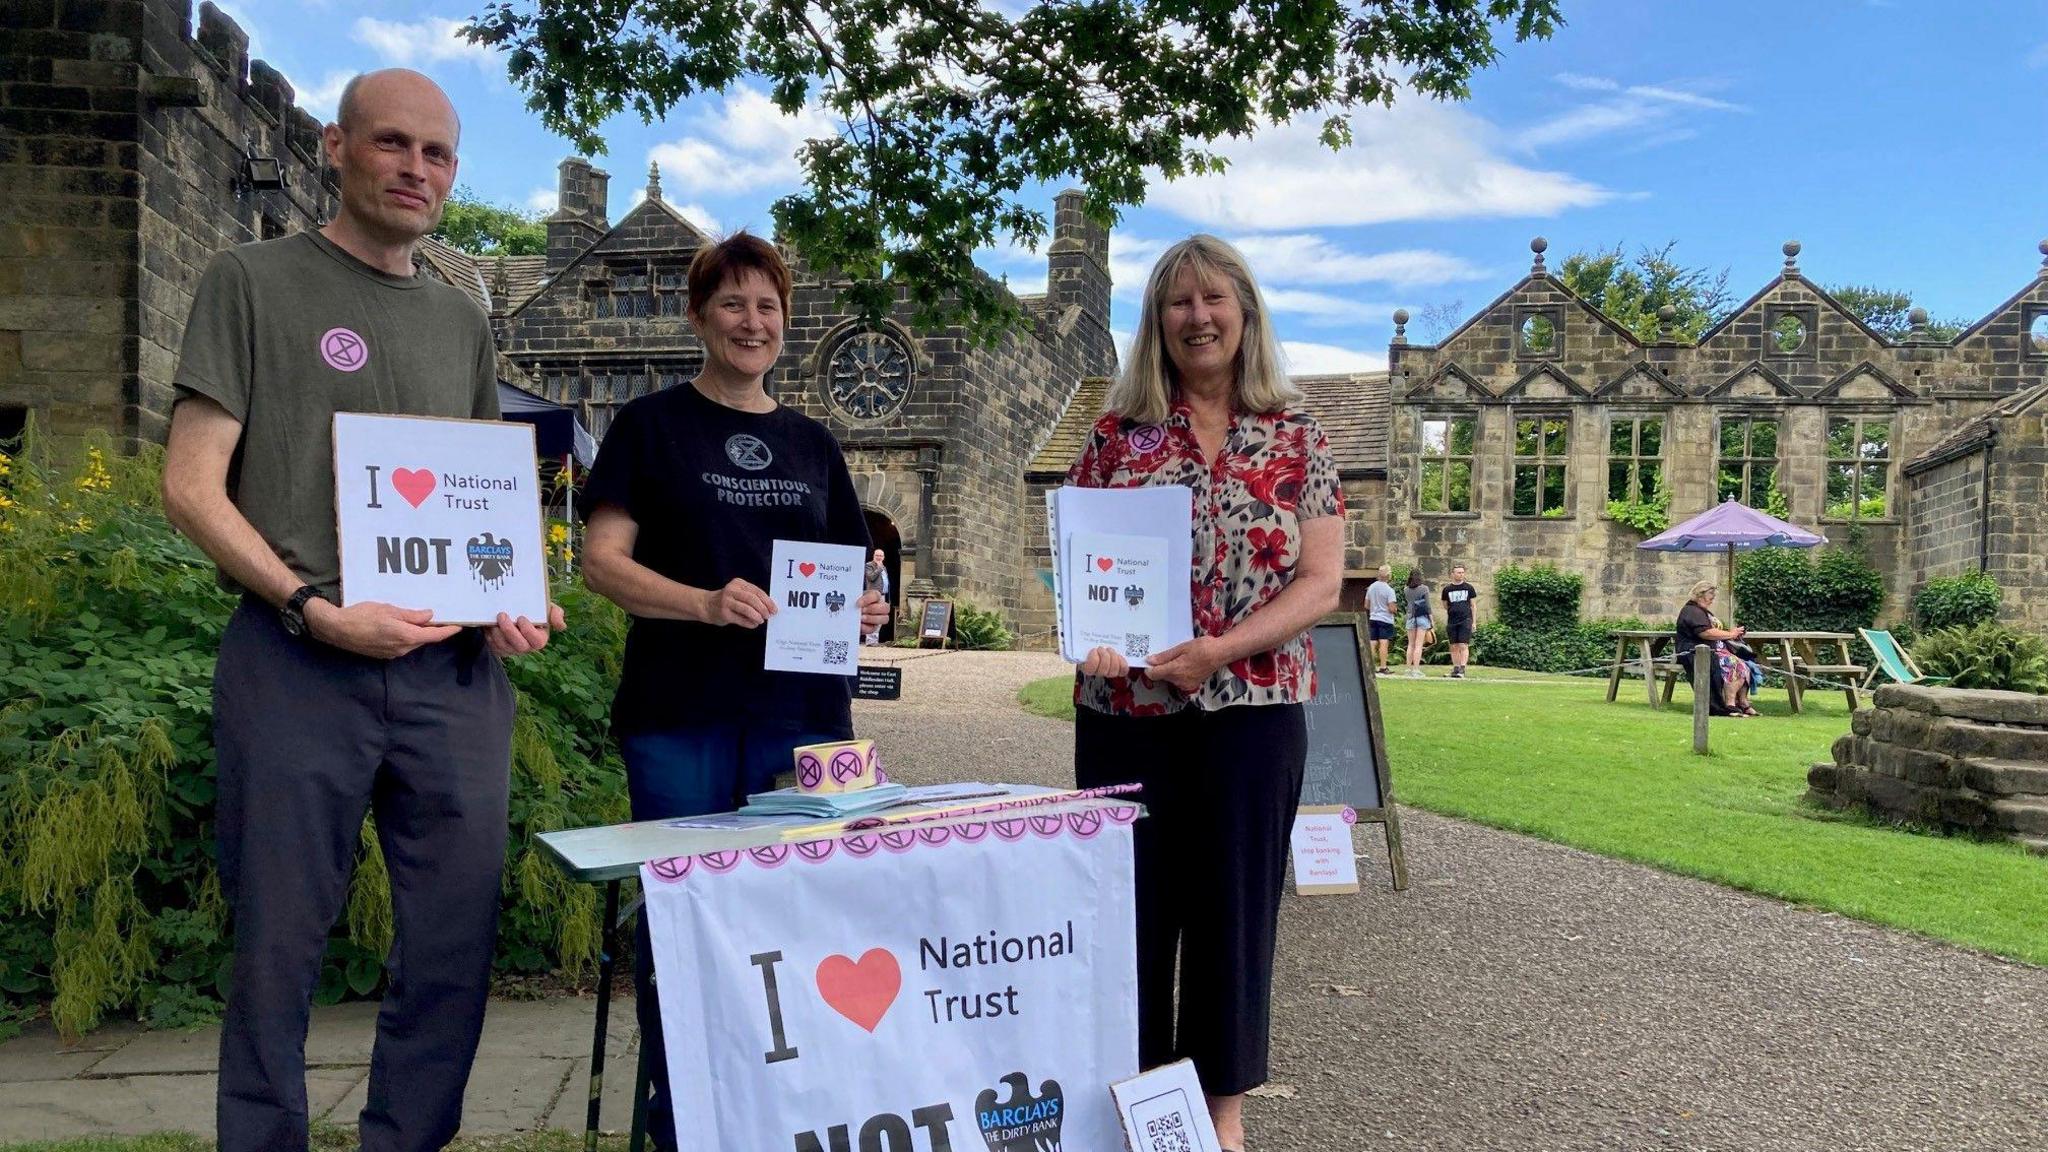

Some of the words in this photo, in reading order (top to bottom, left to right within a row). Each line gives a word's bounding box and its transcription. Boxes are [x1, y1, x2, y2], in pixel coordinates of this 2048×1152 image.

[366, 465, 382, 508] I
[444, 473, 517, 491] National
[702, 472, 811, 494] CONSCIENTIOUS
[444, 495, 489, 510] Trust
[717, 488, 802, 506] PROTECTOR
[377, 536, 451, 575] NOT
[470, 544, 511, 555] BARCLAYS
[787, 559, 794, 578] I
[820, 563, 851, 572] National
[1086, 554, 1092, 573] I
[1117, 558, 1149, 566] National
[1117, 567, 1136, 575] Trust
[820, 572, 838, 581] Trust
[788, 590, 820, 609] NOT
[1088, 584, 1119, 602] NOT
[750, 950, 799, 1065] I
[919, 920, 1074, 971] National
[924, 985, 1019, 1025] Trust
[980, 1098, 1059, 1129] BARCLAYS
[985, 1129, 1000, 1144] THE
[1001, 1122, 1031, 1140] DIRTY
[1032, 1117, 1058, 1136] BANK
